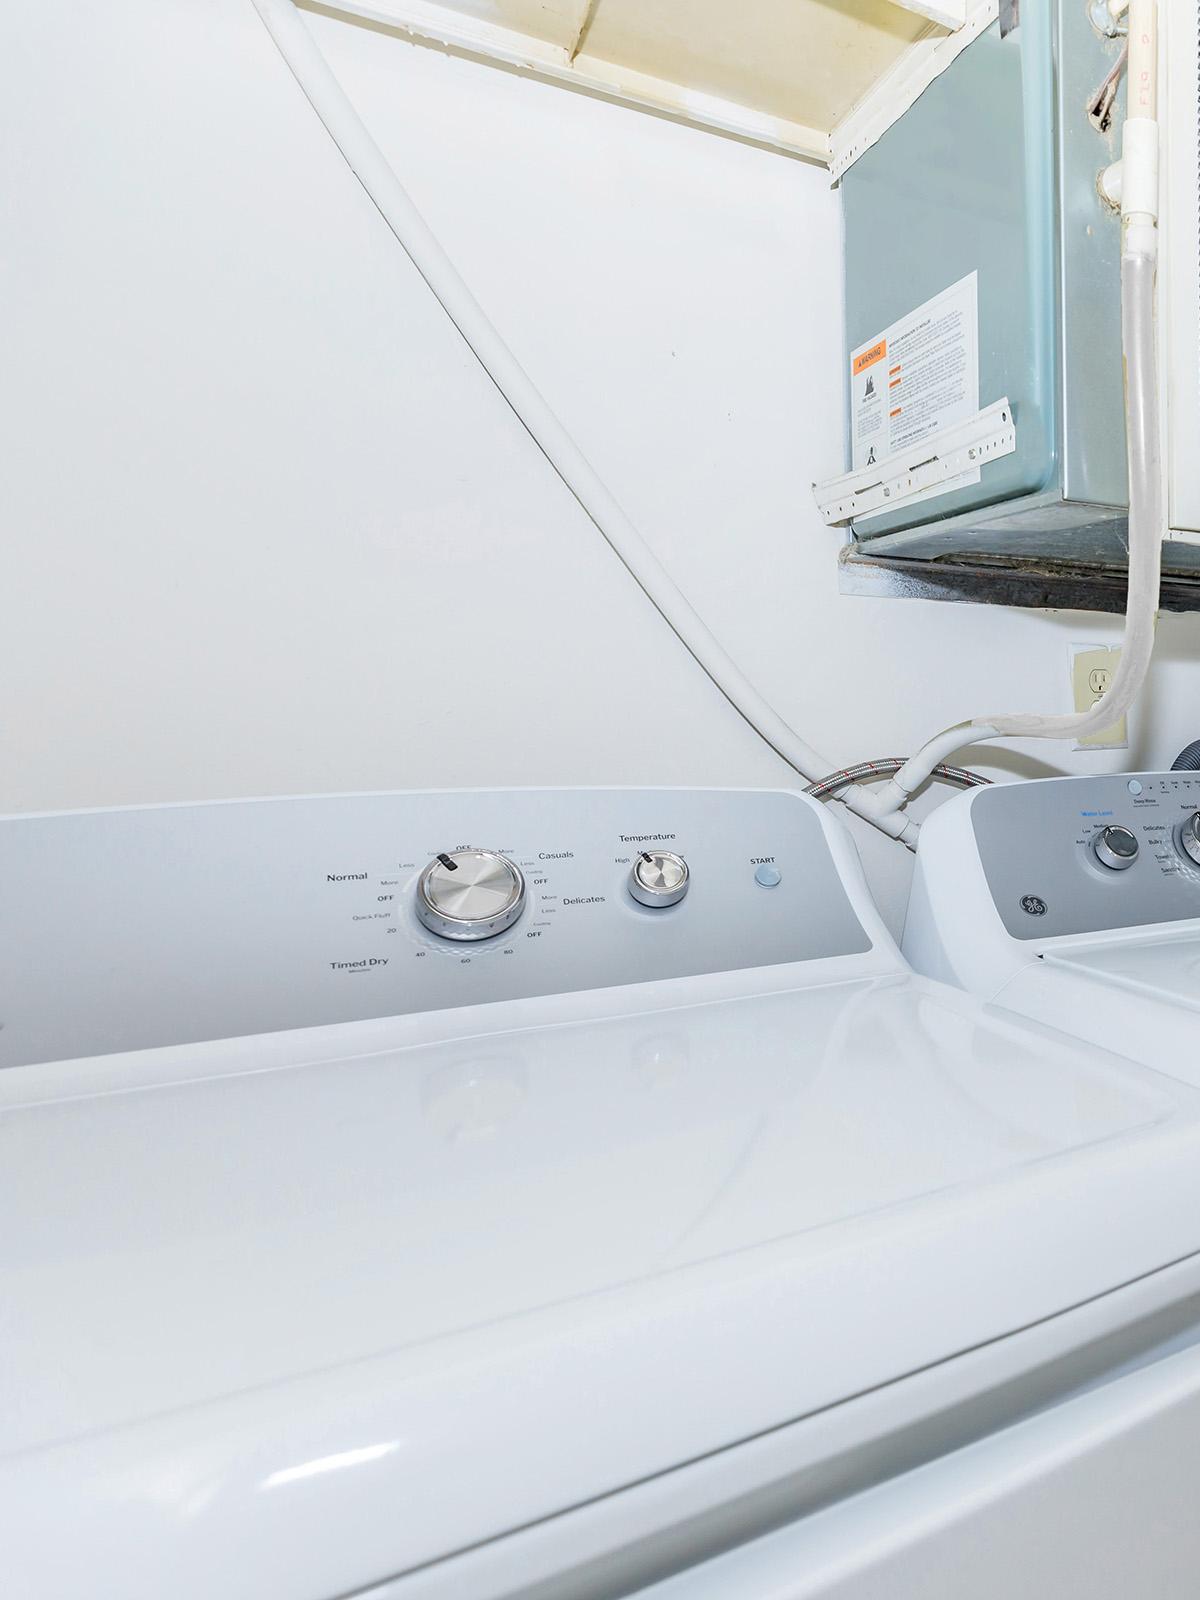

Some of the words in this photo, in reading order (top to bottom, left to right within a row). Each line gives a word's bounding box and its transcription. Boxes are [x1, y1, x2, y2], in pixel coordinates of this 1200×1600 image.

[862, 347, 881, 365] WARNING
[619, 832, 676, 842] Temperature
[538, 851, 574, 860] Casuals
[615, 857, 630, 865] High
[750, 857, 775, 865] START
[327, 872, 368, 882] Normal
[563, 895, 606, 905] Delicates
[330, 959, 367, 970] Timed
[368, 958, 389, 967] Dry
